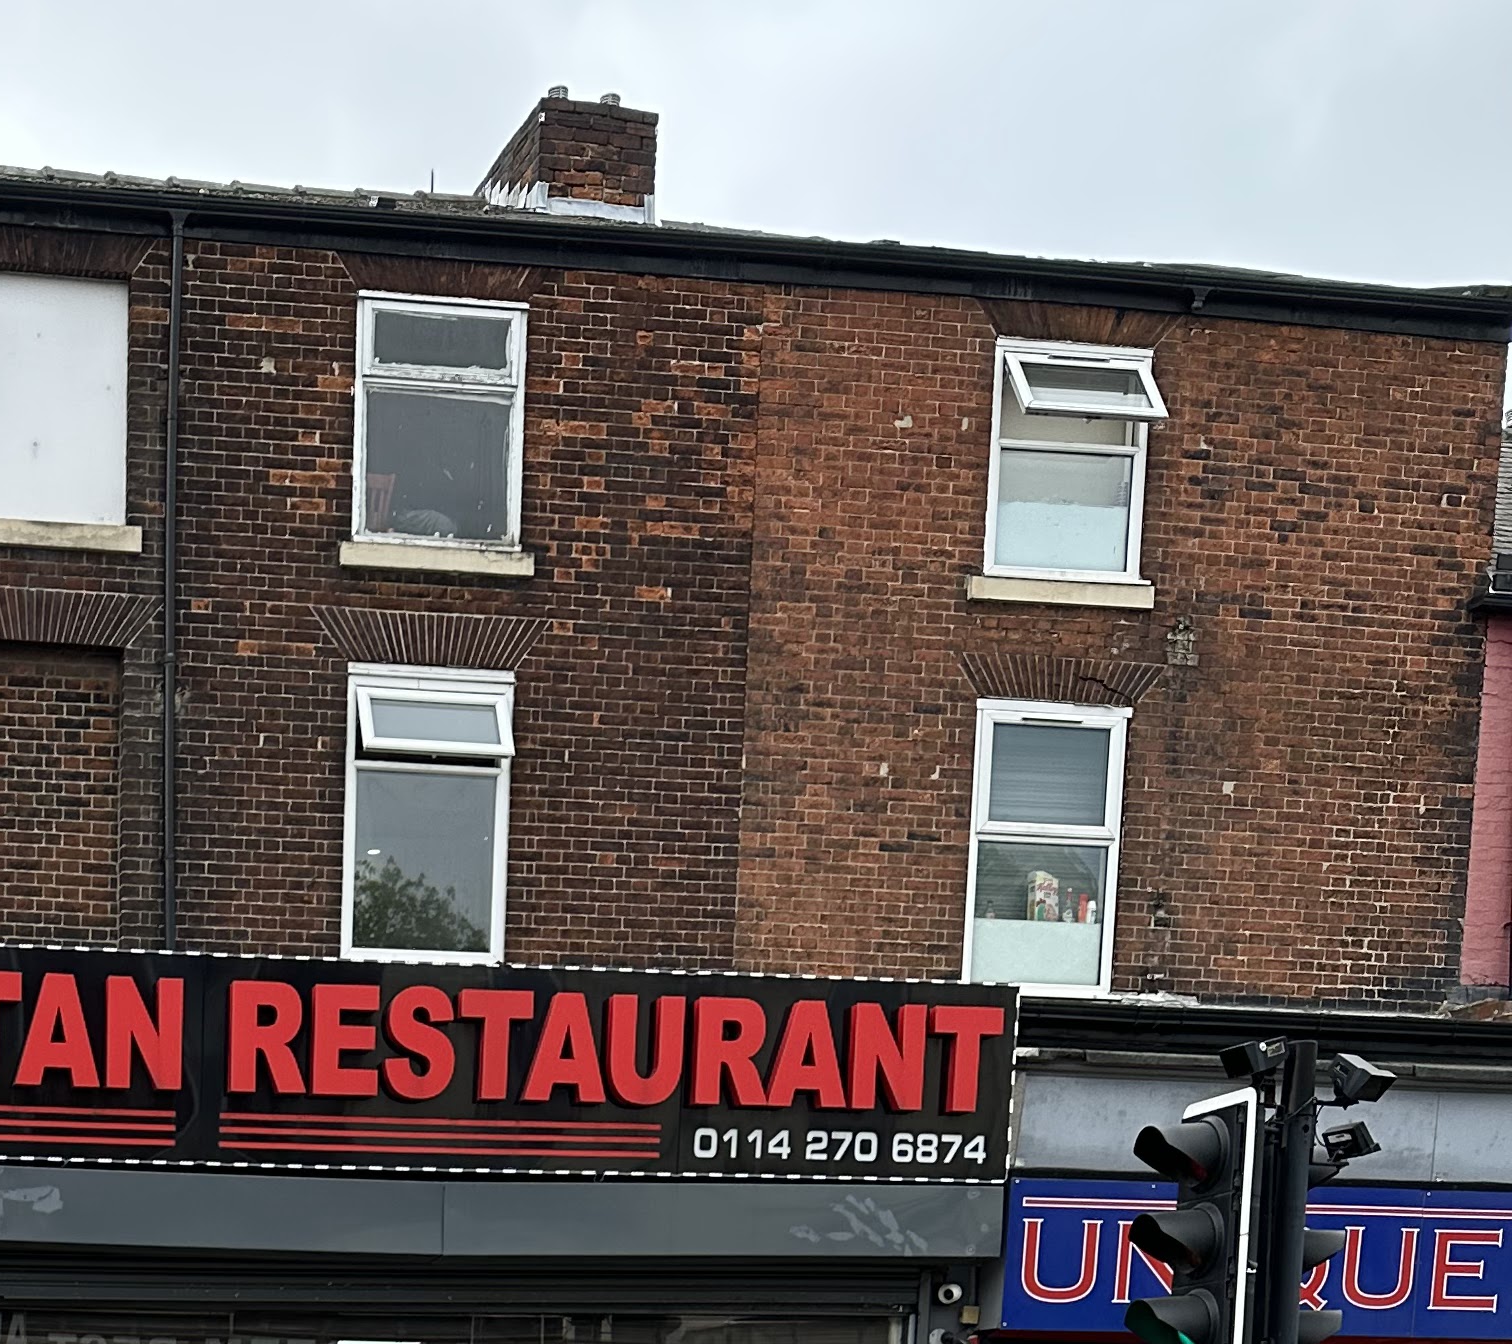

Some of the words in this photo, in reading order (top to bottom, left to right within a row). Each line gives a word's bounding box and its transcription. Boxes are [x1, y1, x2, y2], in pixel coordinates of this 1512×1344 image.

[226, 980, 1005, 1113] RESTAURANT
[693, 1128, 790, 1160] 0114
[805, 1131, 877, 1162] 270
[891, 1133, 987, 1165] 6874
